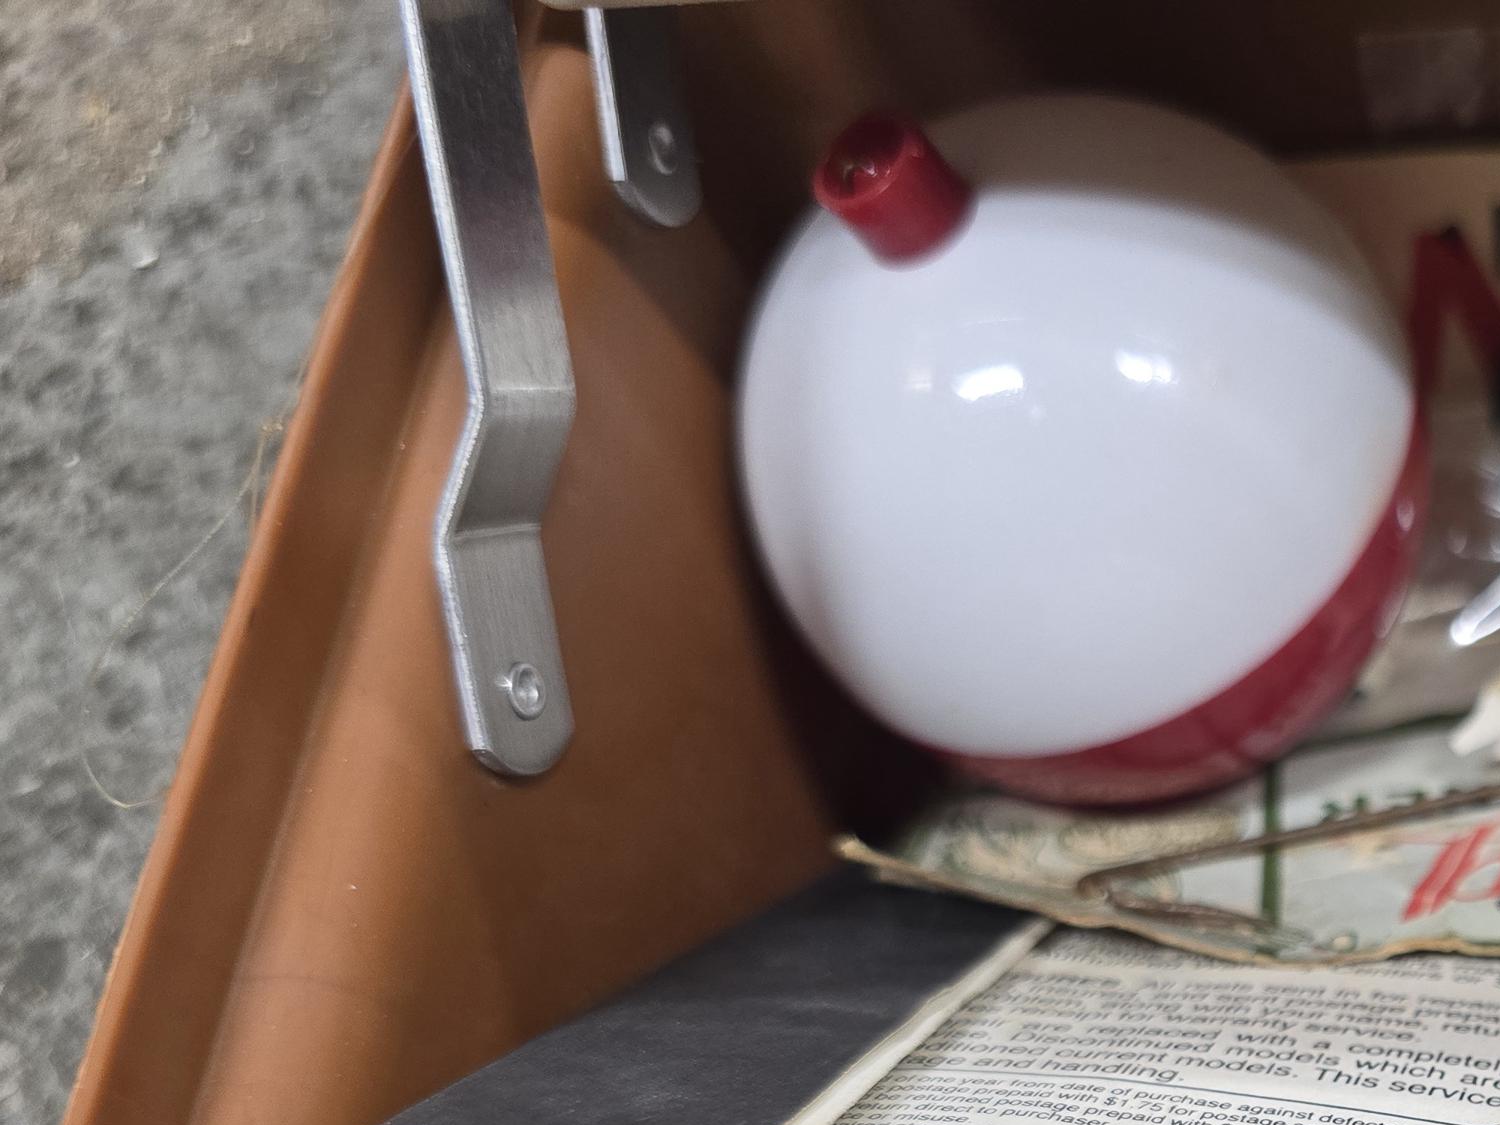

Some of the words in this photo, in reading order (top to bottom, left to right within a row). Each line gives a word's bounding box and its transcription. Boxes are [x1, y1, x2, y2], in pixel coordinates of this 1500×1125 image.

[1085, 1026, 1223, 1042] replaced
[1236, 1033, 1297, 1047] with
[1312, 1040, 1332, 1050] a
[1166, 1015, 1297, 1032] warranty
[1303, 1023, 1422, 1042] service.
[972, 1056, 1036, 1070] and
[1040, 1057, 1186, 1084] handling.
[1010, 1030, 1216, 1053] Discontinued
[1224, 1045, 1341, 1067] models
[1355, 1058, 1446, 1081] which
[1054, 1047, 1168, 1063] current
[1174, 1055, 1300, 1078] models.
[1316, 1066, 1379, 1089] This
[889, 1082, 969, 1096] postage
[971, 1086, 1056, 1102] prepaid
[1058, 1091, 1099, 1104] with
[1103, 1095, 1164, 1114] $1.75
[1167, 1104, 1196, 1117] for
[904, 1092, 989, 1107] returned
[992, 1097, 1081, 1113] postage
[1081, 1104, 1168, 1125] prepaid
[914, 1101, 973, 1115] direct
[976, 1104, 999, 1115] to
[958, 1077, 1003, 1090] year
[1010, 1079, 1056, 1091] from
[1060, 1081, 1106, 1094] date
[1110, 1086, 1132, 1098] of
[1132, 1090, 1232, 1111] purchase
[1236, 1103, 1314, 1123] against
[868, 1112, 891, 1121] or
[893, 1111, 973, 1125] misuse.
